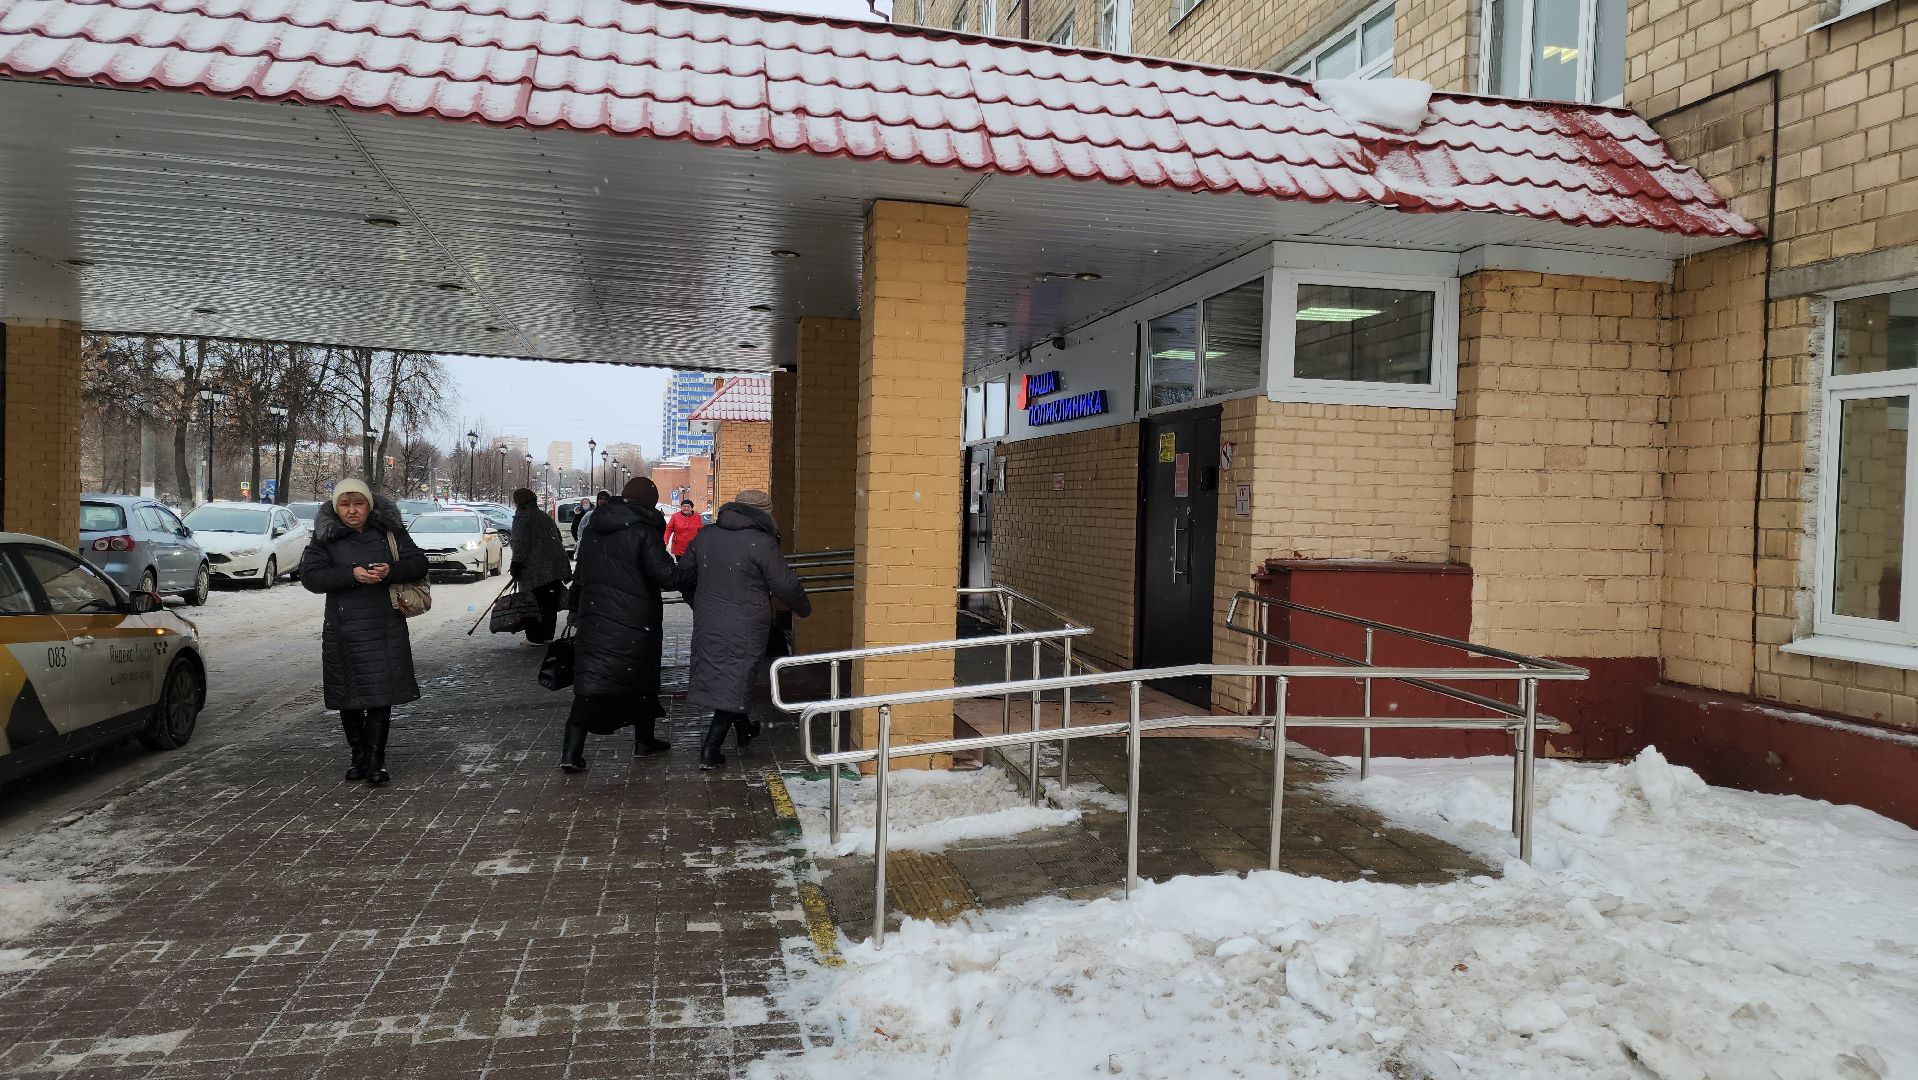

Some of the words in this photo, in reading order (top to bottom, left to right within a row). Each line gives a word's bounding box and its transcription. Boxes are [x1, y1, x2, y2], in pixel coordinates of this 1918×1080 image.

[1028, 372, 1056, 398] НАША
[1028, 391, 1103, 426] ПОЛИКЛИНИКА
[47, 646, 67, 668] 083
[109, 644, 134, 665] Яндекс
